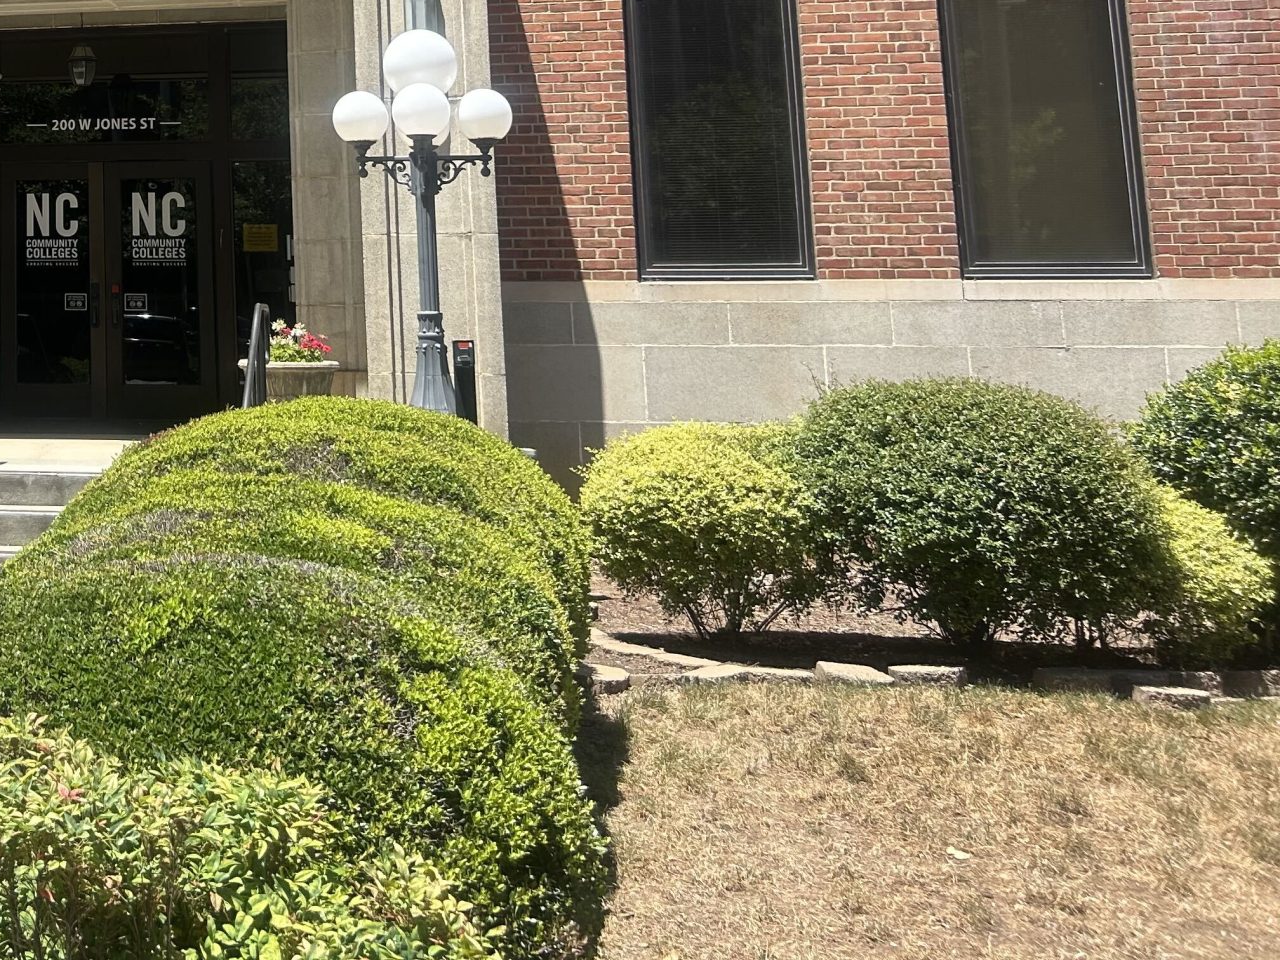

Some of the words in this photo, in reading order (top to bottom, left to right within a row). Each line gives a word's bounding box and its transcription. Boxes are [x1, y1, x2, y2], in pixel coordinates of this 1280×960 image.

[51, 119, 76, 131] 200
[78, 118, 92, 131] W
[94, 118, 137, 130] JONES
[139, 117, 156, 130] ST
[26, 192, 79, 237] NC
[131, 191, 186, 237] NC
[26, 238, 79, 248] COMMUNITY
[131, 238, 186, 248] COMMUNITY
[26, 247, 78, 259] COLLEGES
[132, 247, 186, 259] COLLEGES
